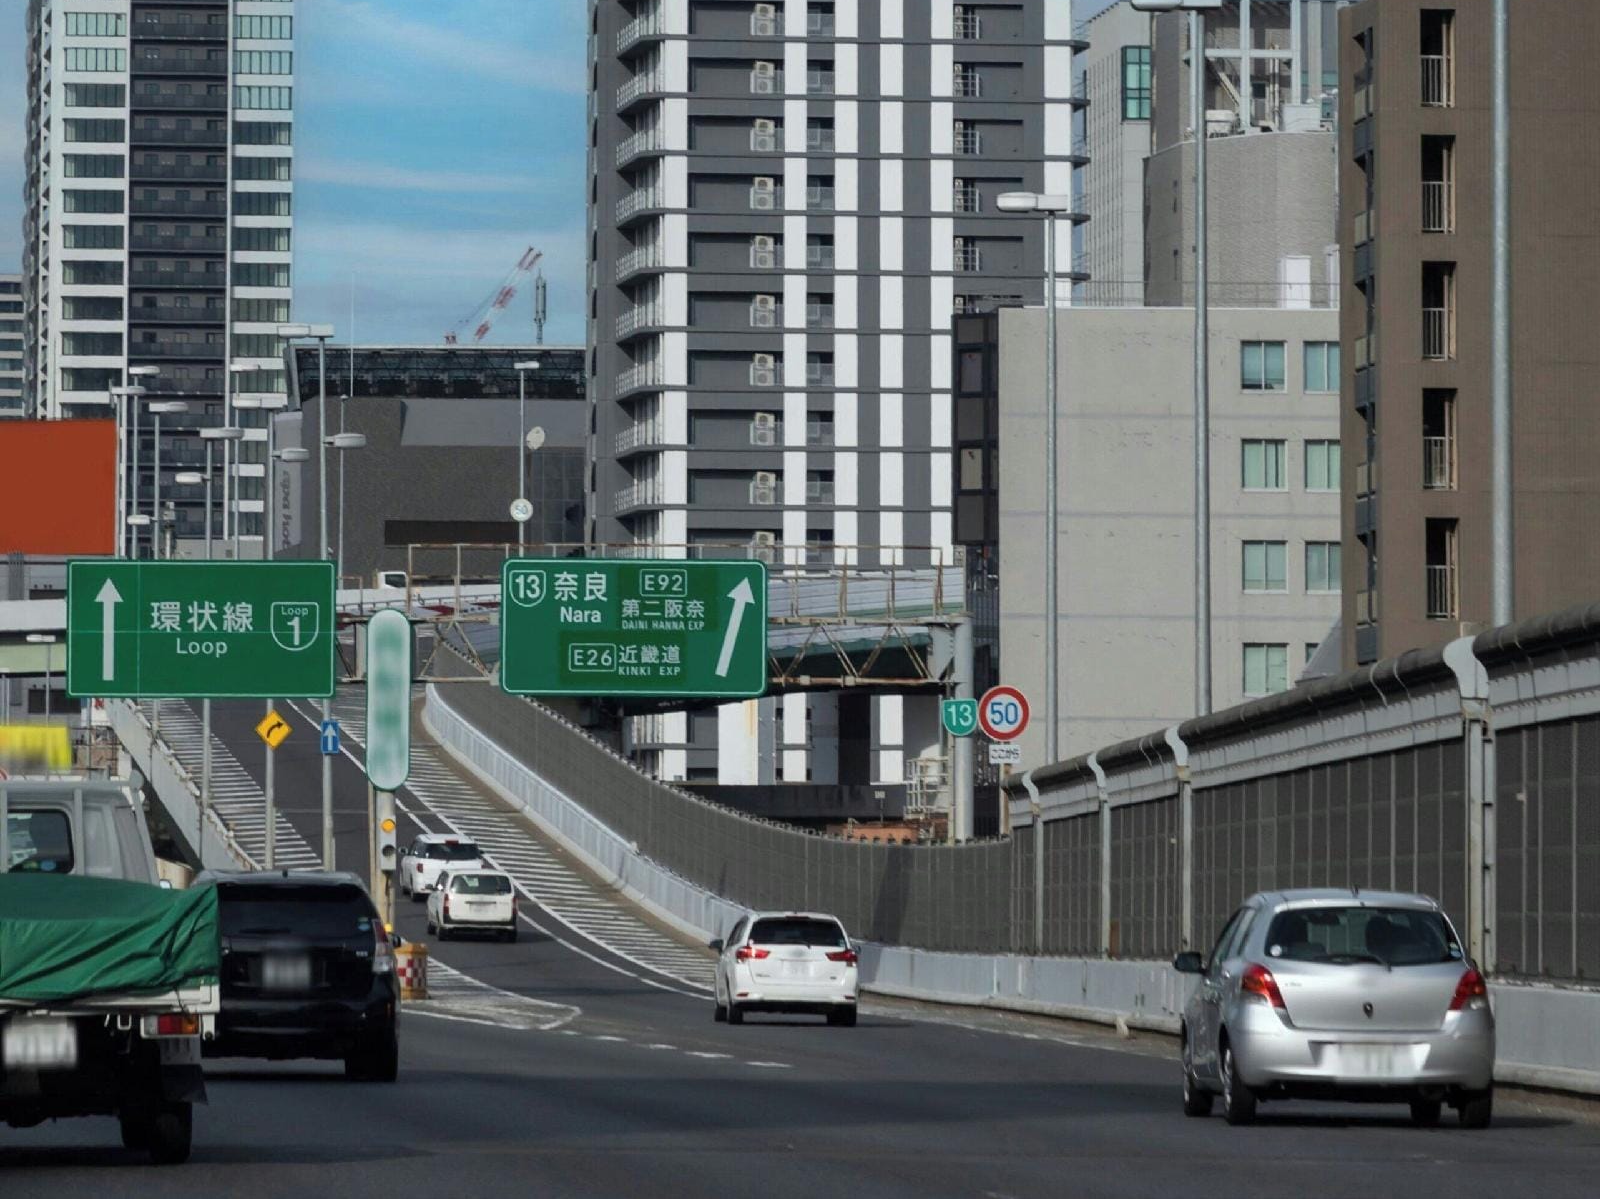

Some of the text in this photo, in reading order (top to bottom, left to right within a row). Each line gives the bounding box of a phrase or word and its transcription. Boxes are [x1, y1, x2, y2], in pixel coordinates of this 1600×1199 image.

[515, 574, 540, 599] 13
[554, 571, 608, 602] 奈良
[644, 574, 683, 591] E92
[150, 601, 253, 633] 環状線
[281, 606, 309, 617] Loop
[560, 606, 602, 623] Nara
[621, 599, 705, 618] 第二阪奈
[287, 616, 300, 646] 1
[621, 621, 705, 631] DAINI HANNA EXP
[176, 637, 228, 658] Loop
[573, 645, 681, 666] E26 近畿道
[618, 666, 681, 676] KINKI EXP
[948, 704, 973, 726] 13
[991, 702, 1018, 725] 50
